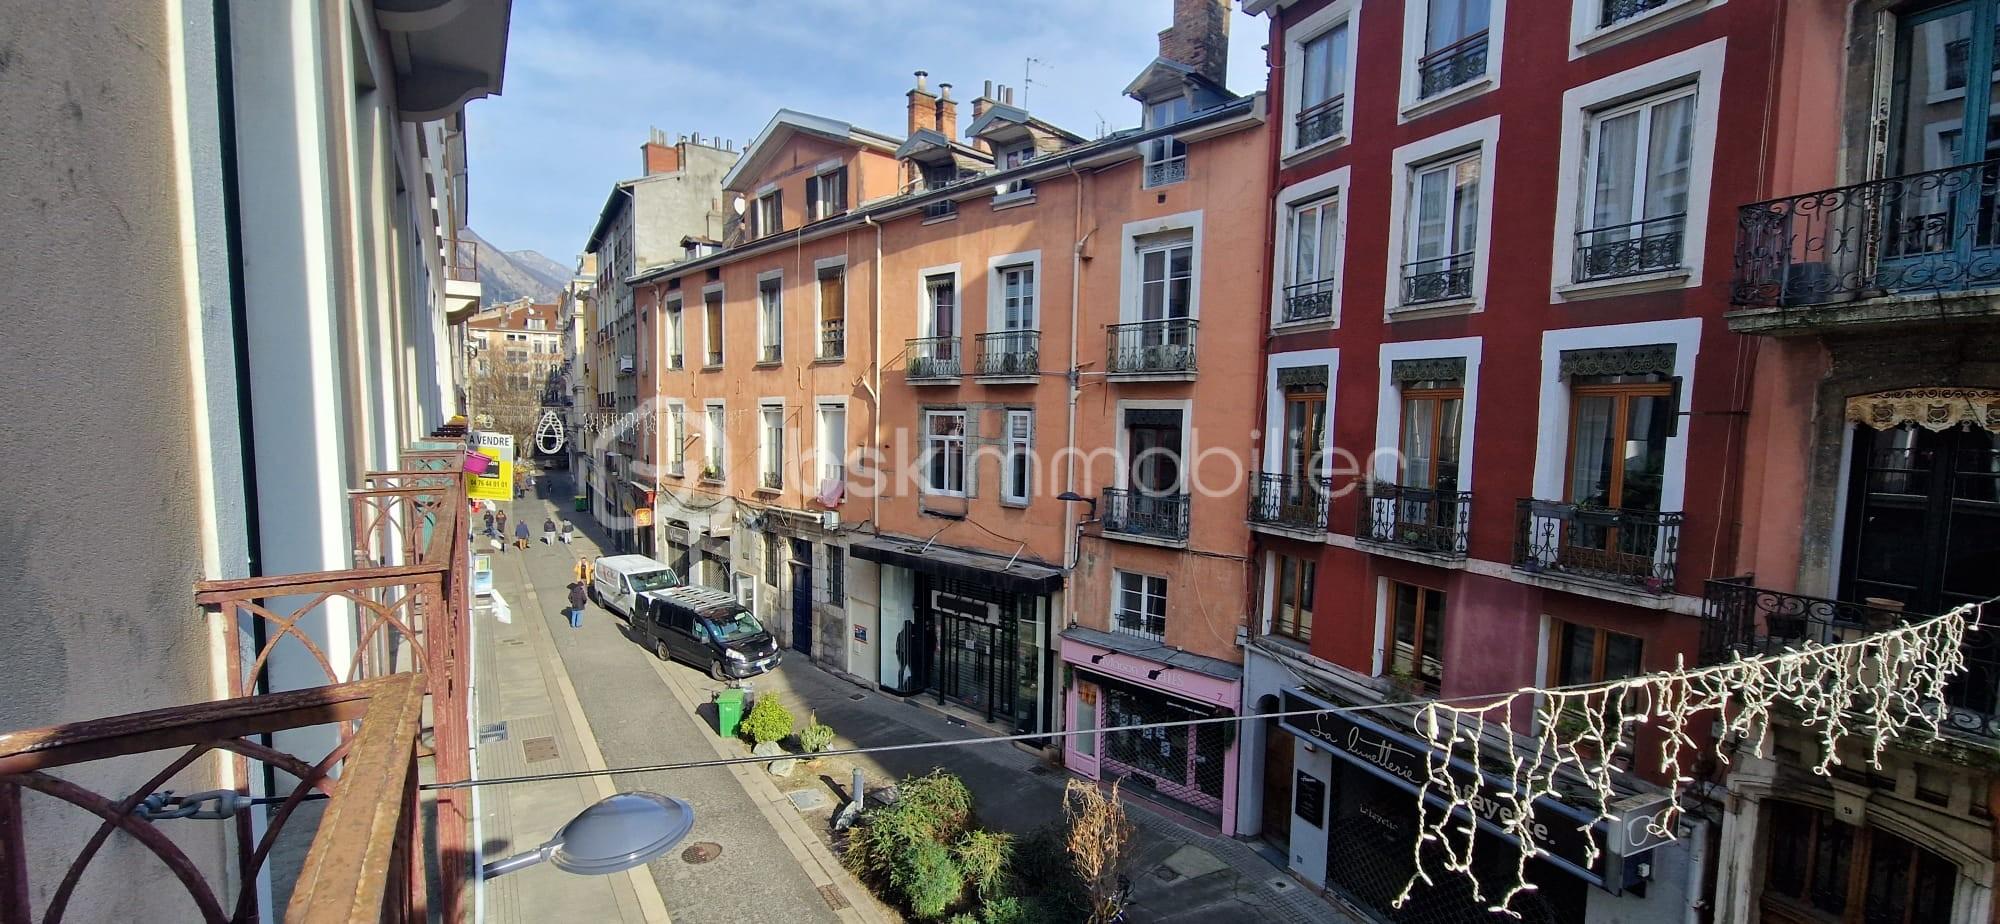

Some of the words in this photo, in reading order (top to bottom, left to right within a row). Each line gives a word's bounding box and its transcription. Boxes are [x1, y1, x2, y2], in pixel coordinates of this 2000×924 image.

[469, 435, 475, 445] A
[477, 435, 509, 446] VENDRE
[1347, 726, 1422, 784] lunetterie
[1438, 772, 1556, 845] Lafayete.
